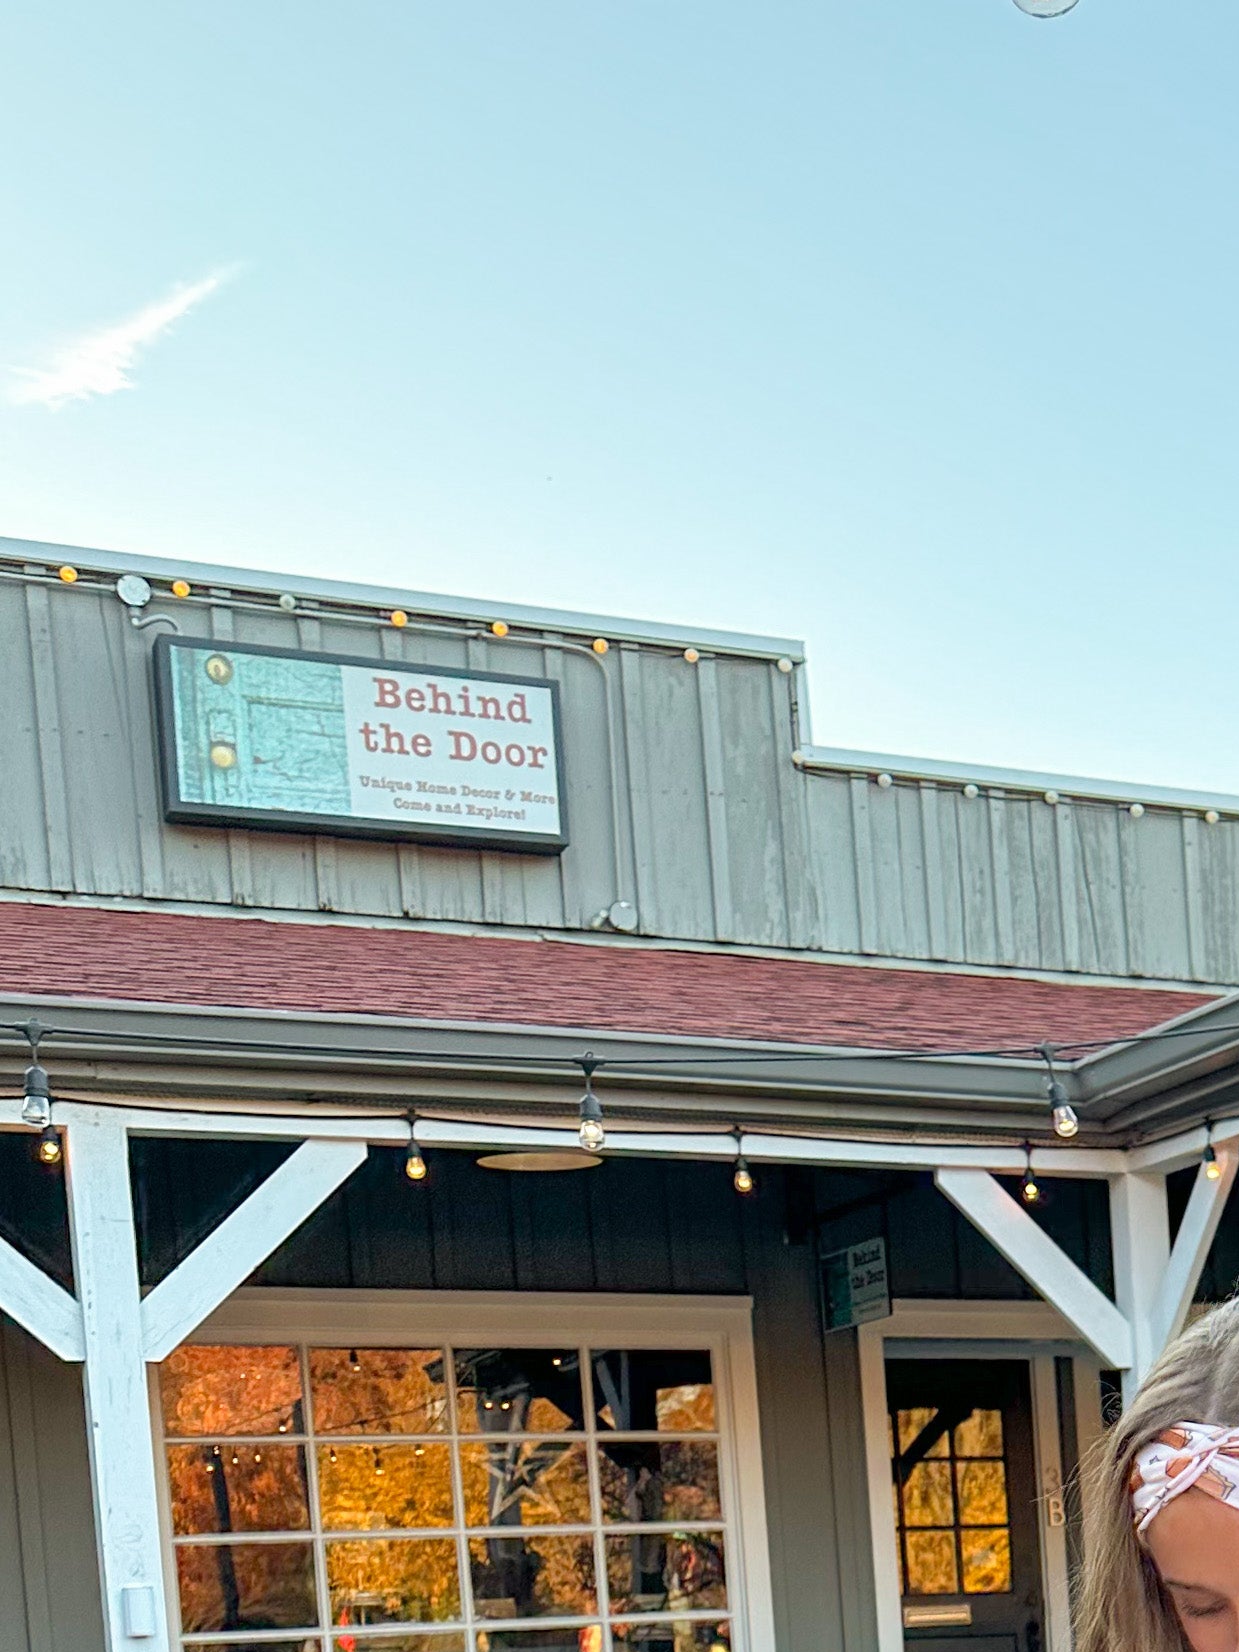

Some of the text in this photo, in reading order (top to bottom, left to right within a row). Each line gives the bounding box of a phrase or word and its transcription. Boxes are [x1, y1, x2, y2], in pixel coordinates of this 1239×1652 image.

[373, 677, 532, 724] Behind
[359, 722, 548, 769] the Door
[359, 775, 556, 805] Unique Home Decor & More
[394, 798, 527, 821] Come and Explore!
[1049, 1500, 1065, 1527] B
